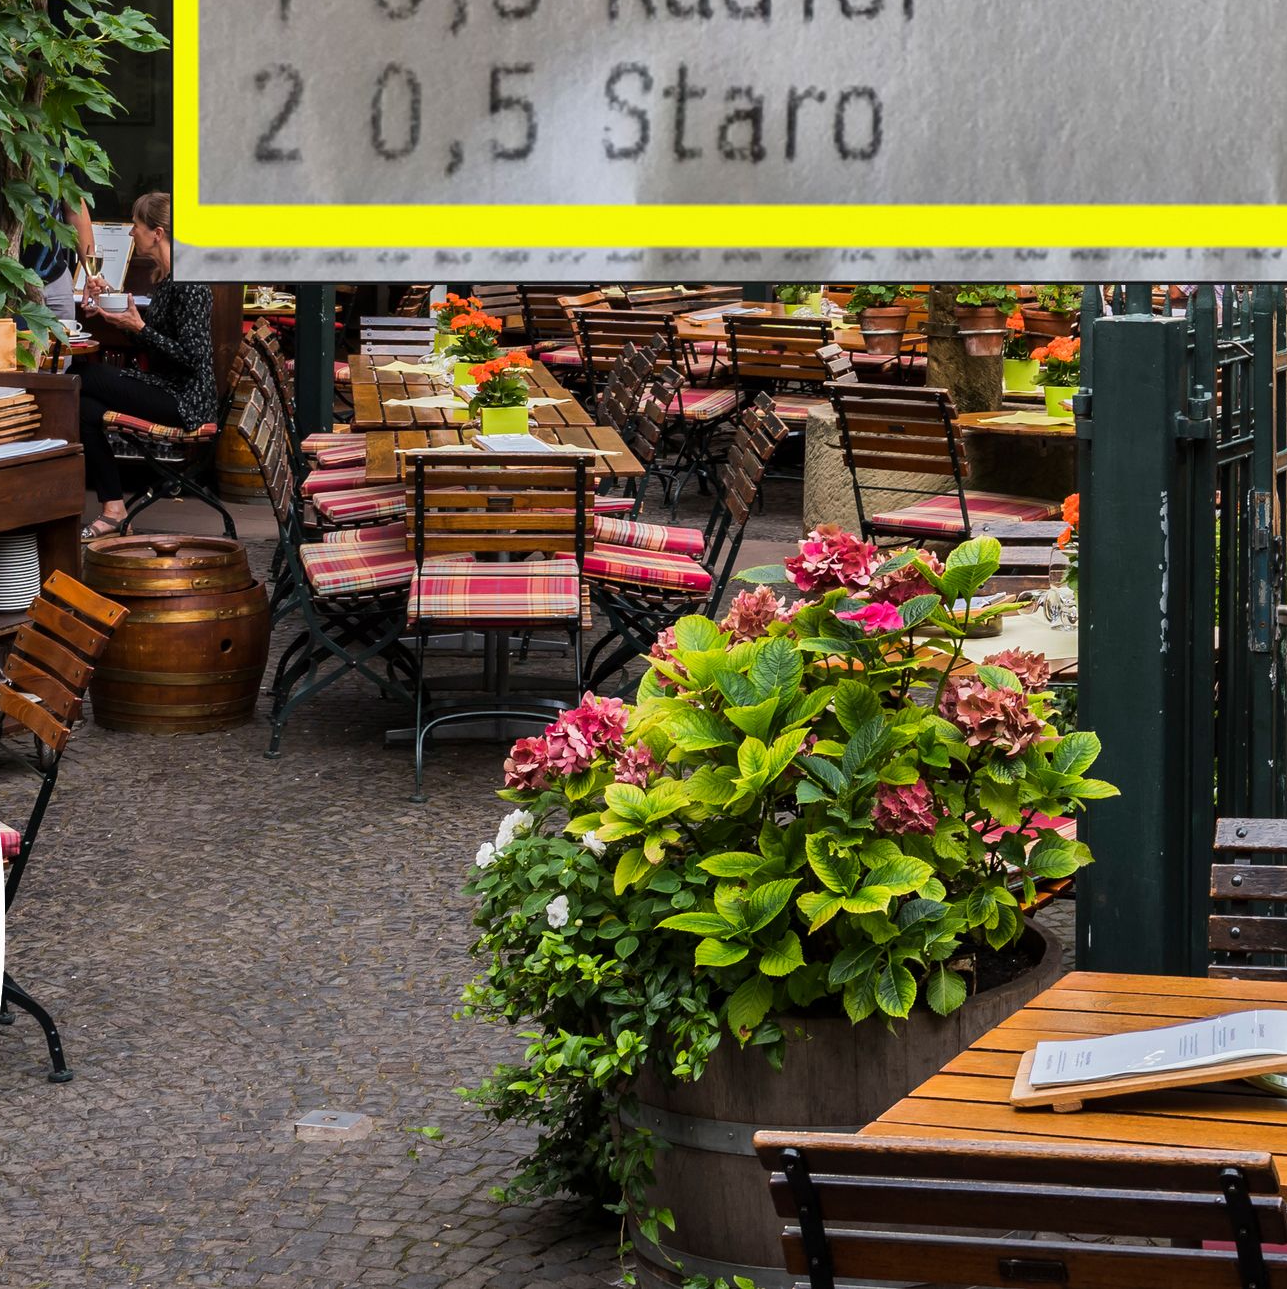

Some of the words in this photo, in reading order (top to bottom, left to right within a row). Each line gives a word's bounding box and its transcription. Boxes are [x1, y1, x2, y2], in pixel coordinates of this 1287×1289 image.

[255, 65, 302, 163] 2
[371, 63, 536, 175] 0,5
[606, 64, 882, 164] Staro
